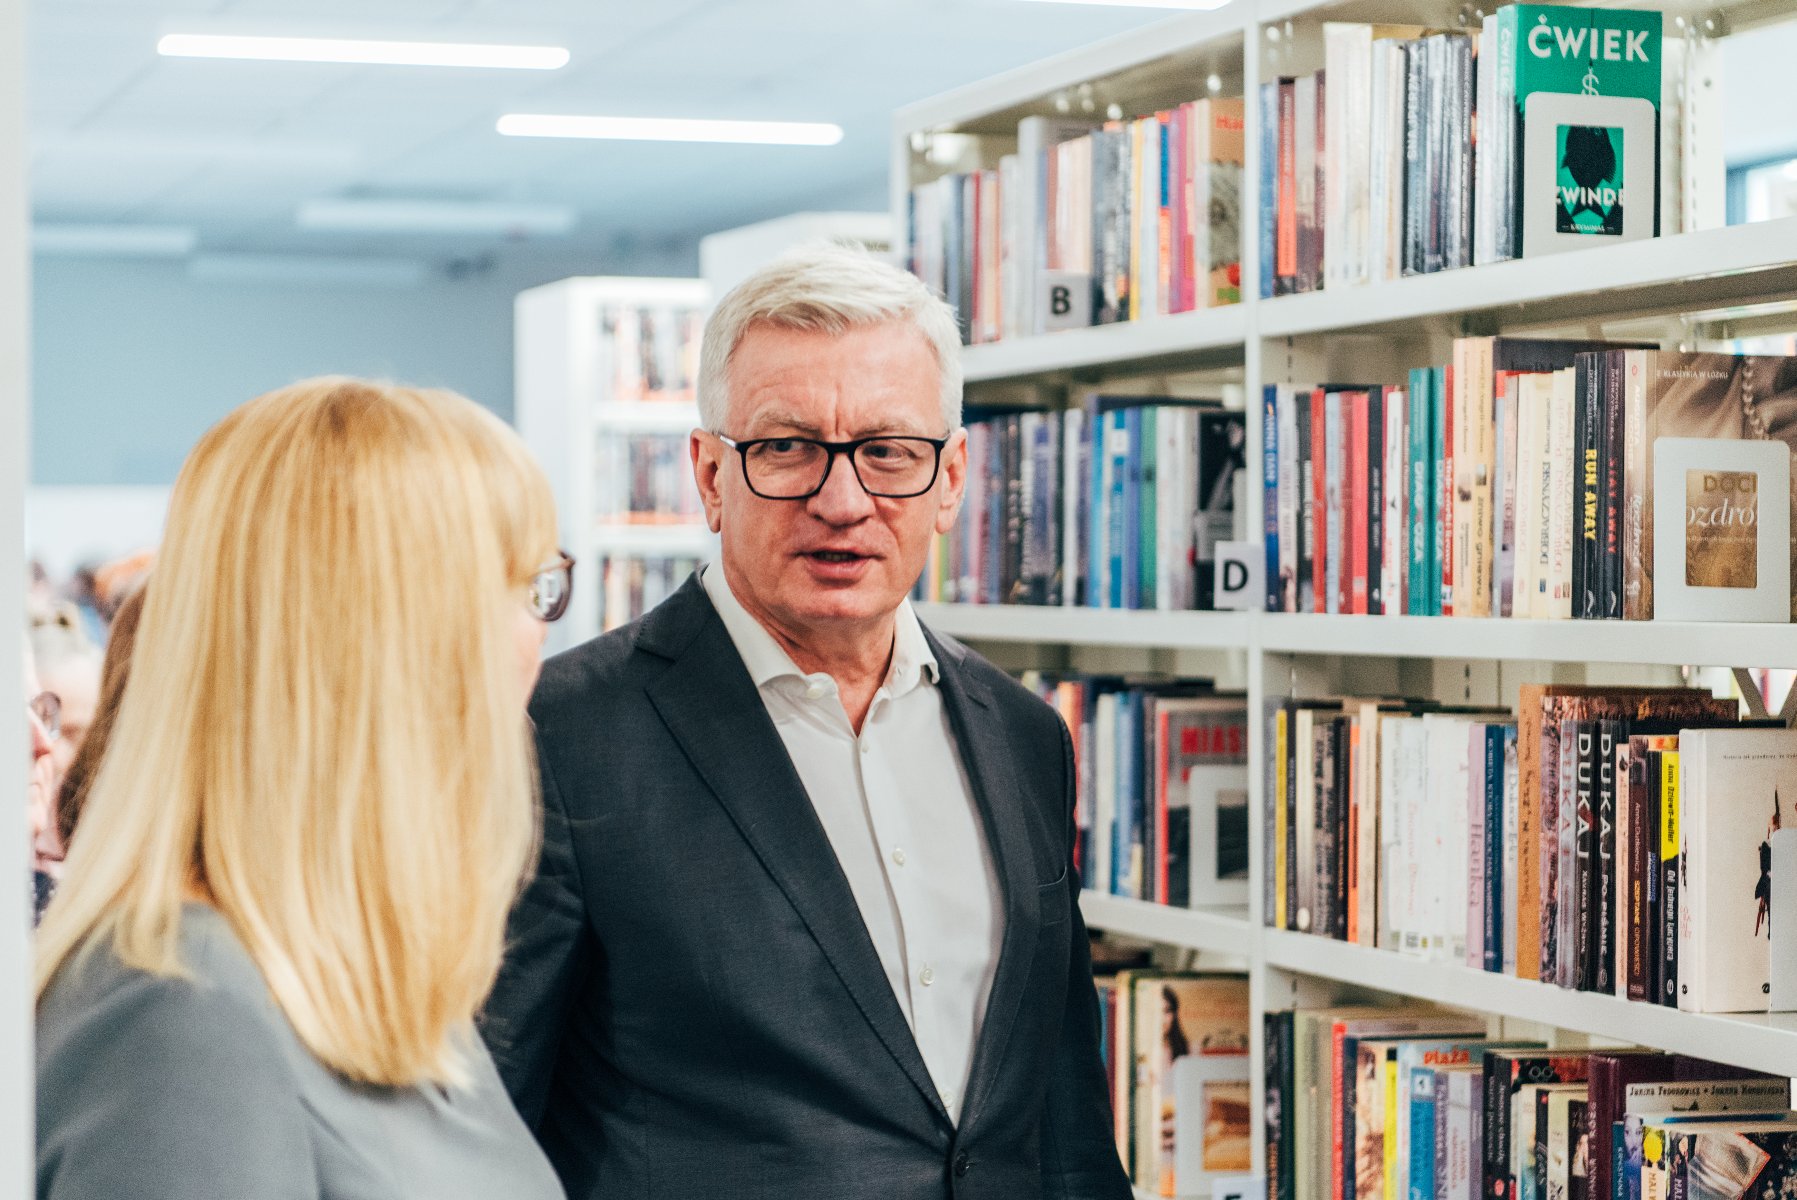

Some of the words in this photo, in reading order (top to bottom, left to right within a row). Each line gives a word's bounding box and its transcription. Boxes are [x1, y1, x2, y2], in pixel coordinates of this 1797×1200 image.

[1051, 286, 1071, 316] B
[1585, 448, 1598, 486] RUN
[1703, 474, 1757, 493] DOC
[1584, 491, 1598, 541] AWAY
[1607, 506, 1617, 555] AWAY
[1223, 559, 1249, 592] D
[1577, 733, 1592, 859] DUKAJ
[1600, 732, 1612, 860] DUKAJ
[1602, 873, 1609, 897] PO
